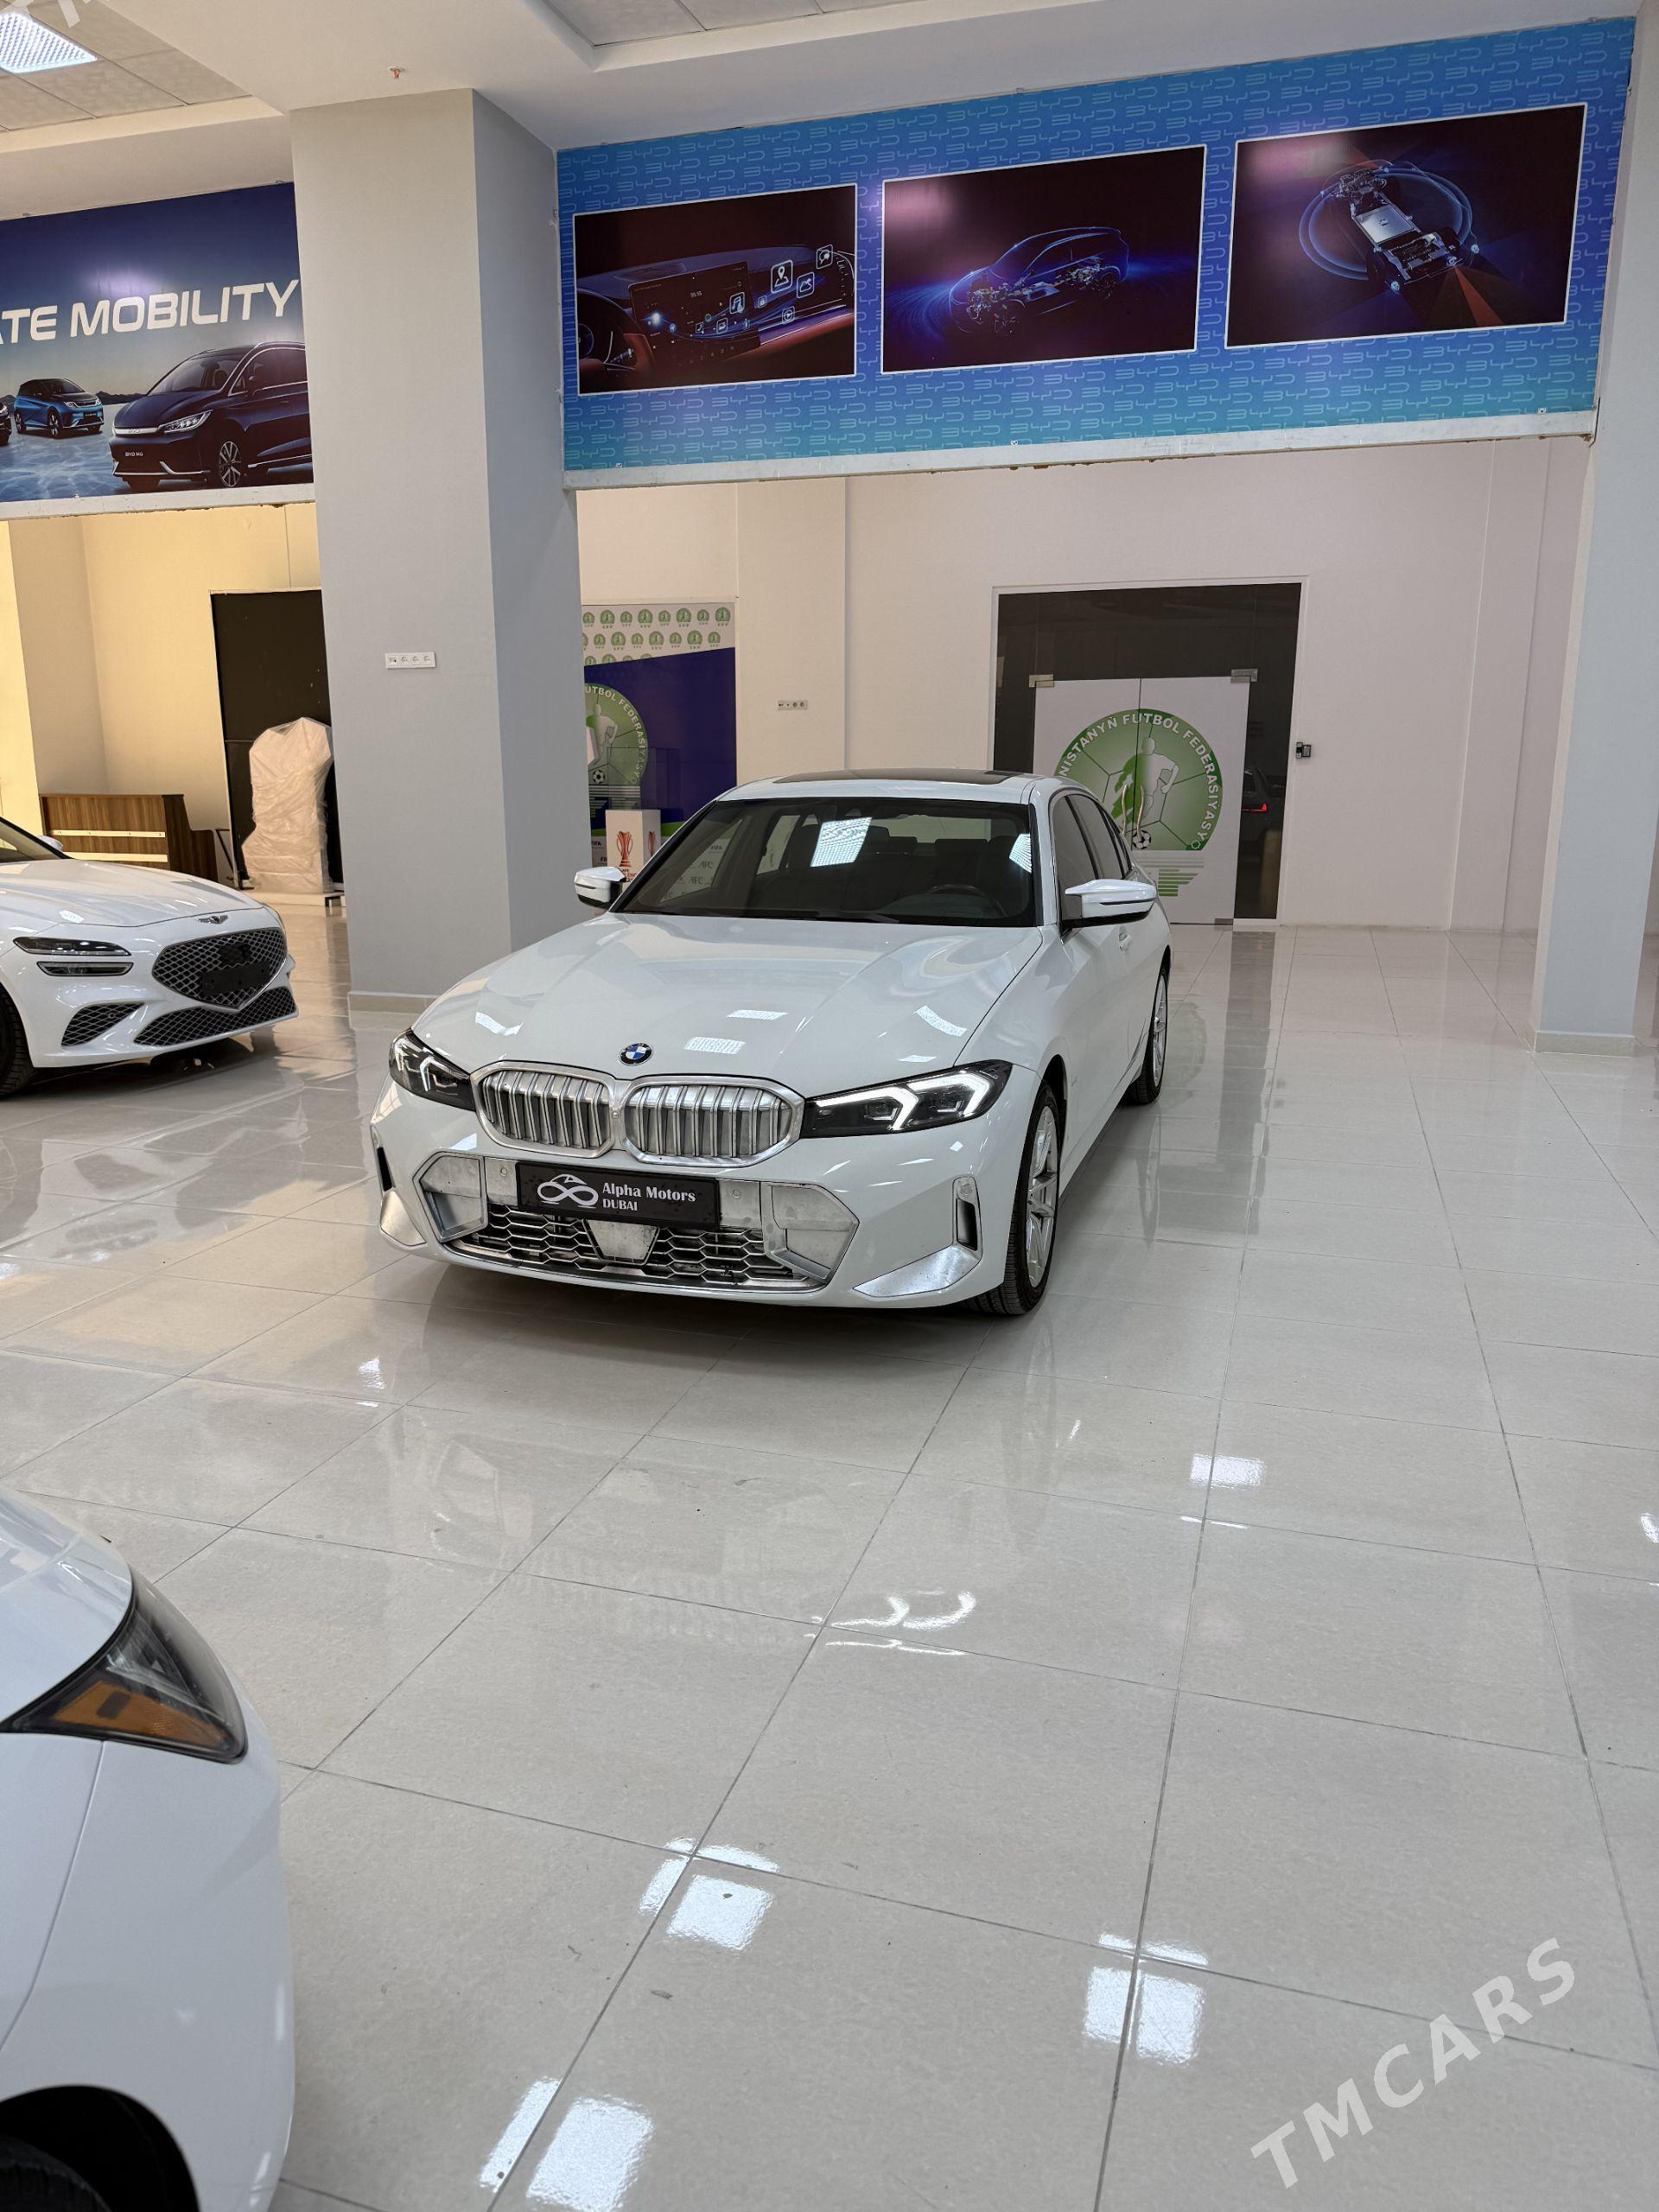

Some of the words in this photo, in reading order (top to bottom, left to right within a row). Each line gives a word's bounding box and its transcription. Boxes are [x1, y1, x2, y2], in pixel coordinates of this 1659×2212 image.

[0, 305, 58, 345] TE
[70, 279, 300, 338] MOBILITY
[584, 685, 616, 702] UTBOL
[1058, 716, 1117, 777] NISTANYŇ
[1123, 713, 1179, 734] FUTBOL
[602, 1182, 642, 1198] Alpha
[646, 1185, 696, 1202] Motors
[602, 1198, 639, 1211] DUBAI
